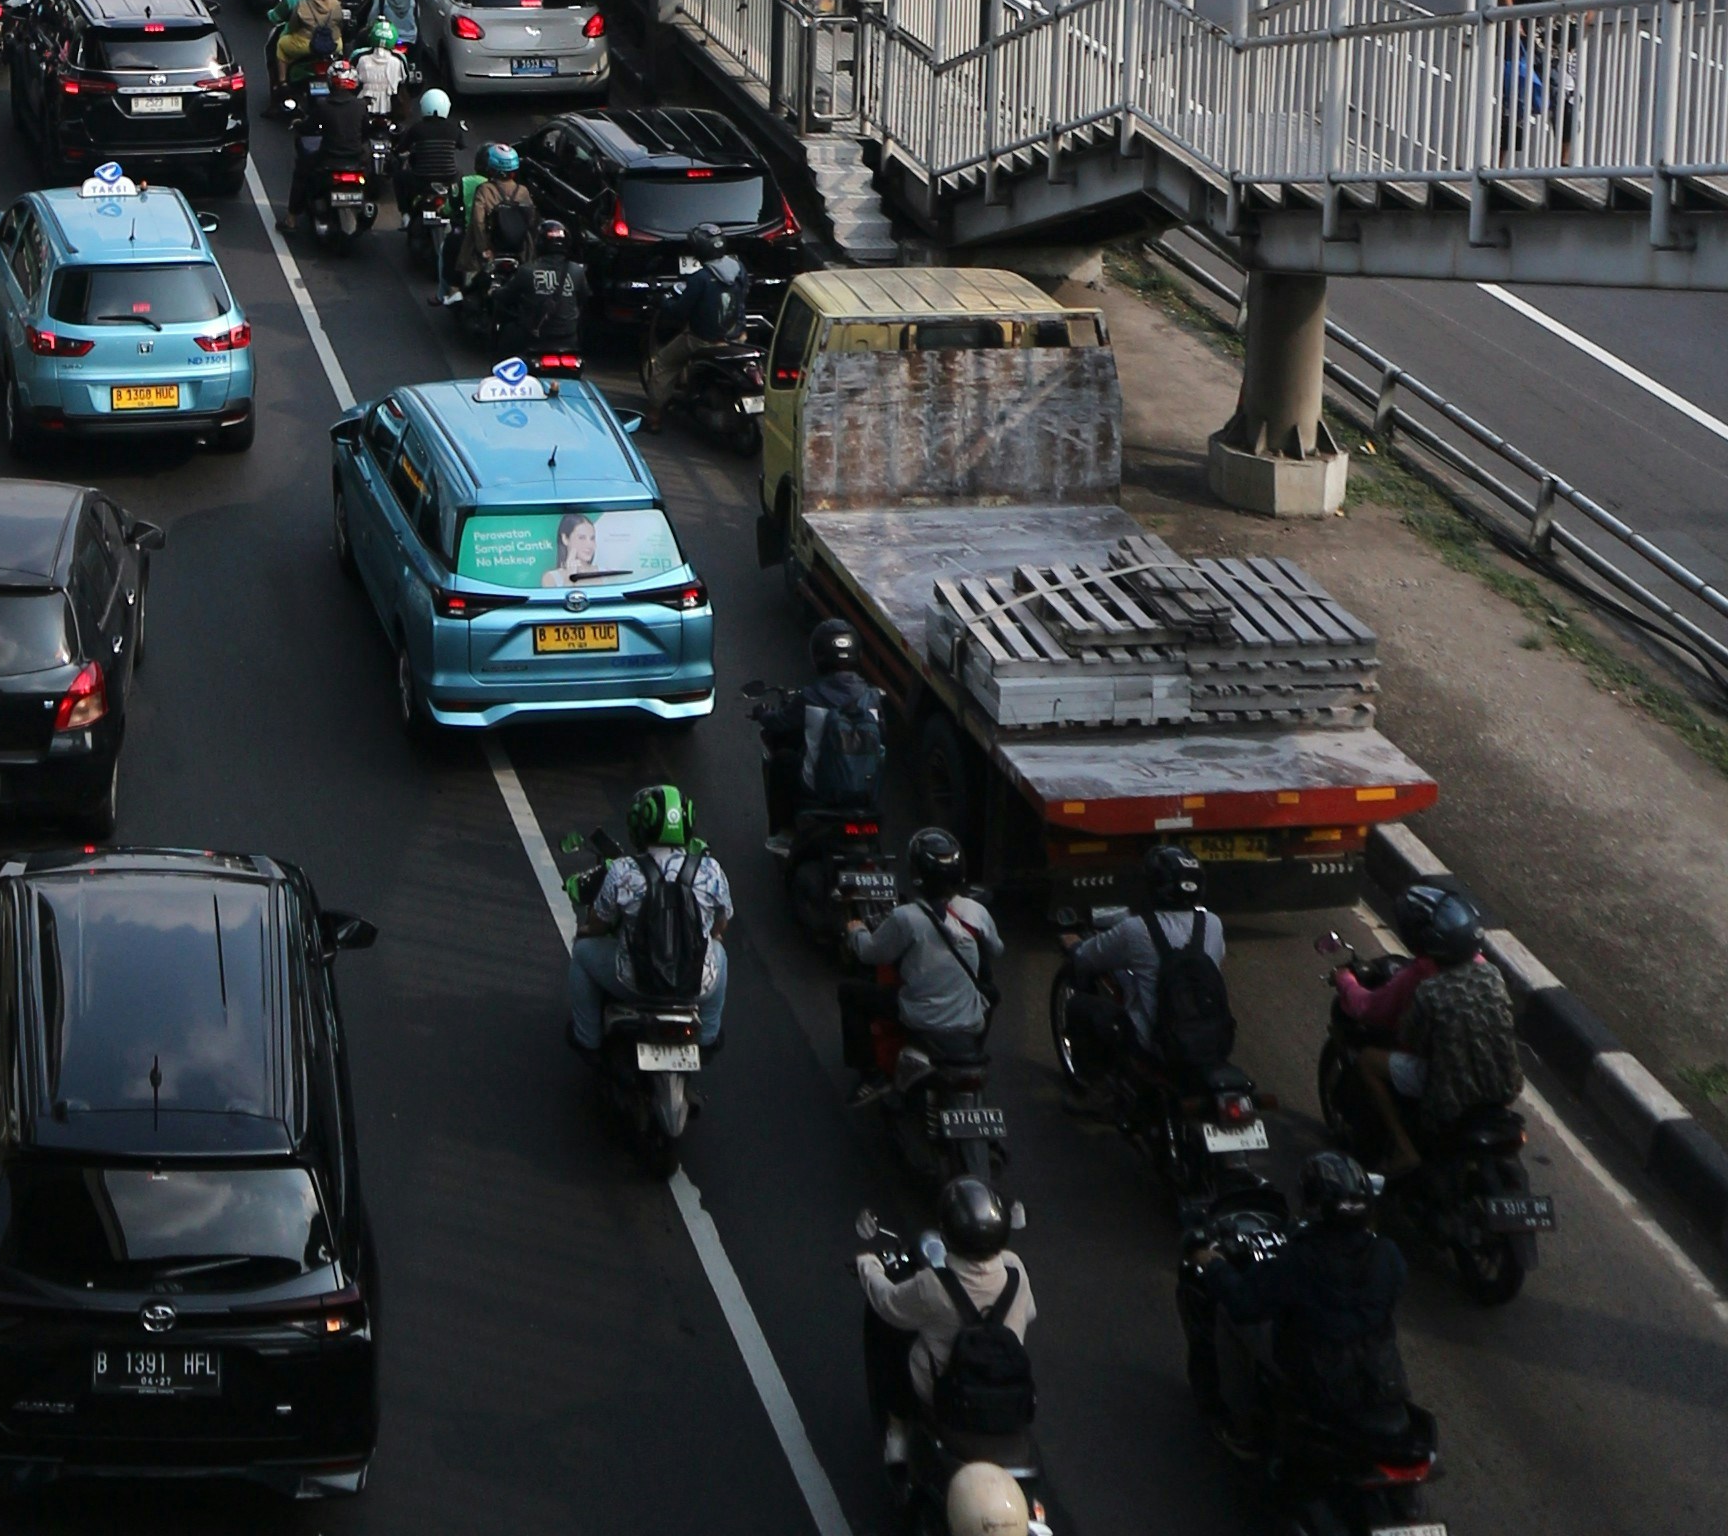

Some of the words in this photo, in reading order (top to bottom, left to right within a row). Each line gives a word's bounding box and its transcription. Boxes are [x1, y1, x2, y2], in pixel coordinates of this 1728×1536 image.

[92, 185, 128, 194] TAKSI
[116, 391, 123, 402] B
[491, 387, 532, 397] TAKSI
[473, 529, 532, 541] Perawatan
[474, 541, 515, 555] Sampai
[516, 539, 553, 552] Cantik
[476, 557, 492, 567] No
[493, 555, 537, 567] Makeup
[640, 555, 673, 570] zap
[538, 627, 547, 642] B
[553, 626, 586, 641] 1630
[97, 1352, 107, 1374] B
[125, 1352, 165, 1374] 1391
[184, 1352, 216, 1375] HFL
